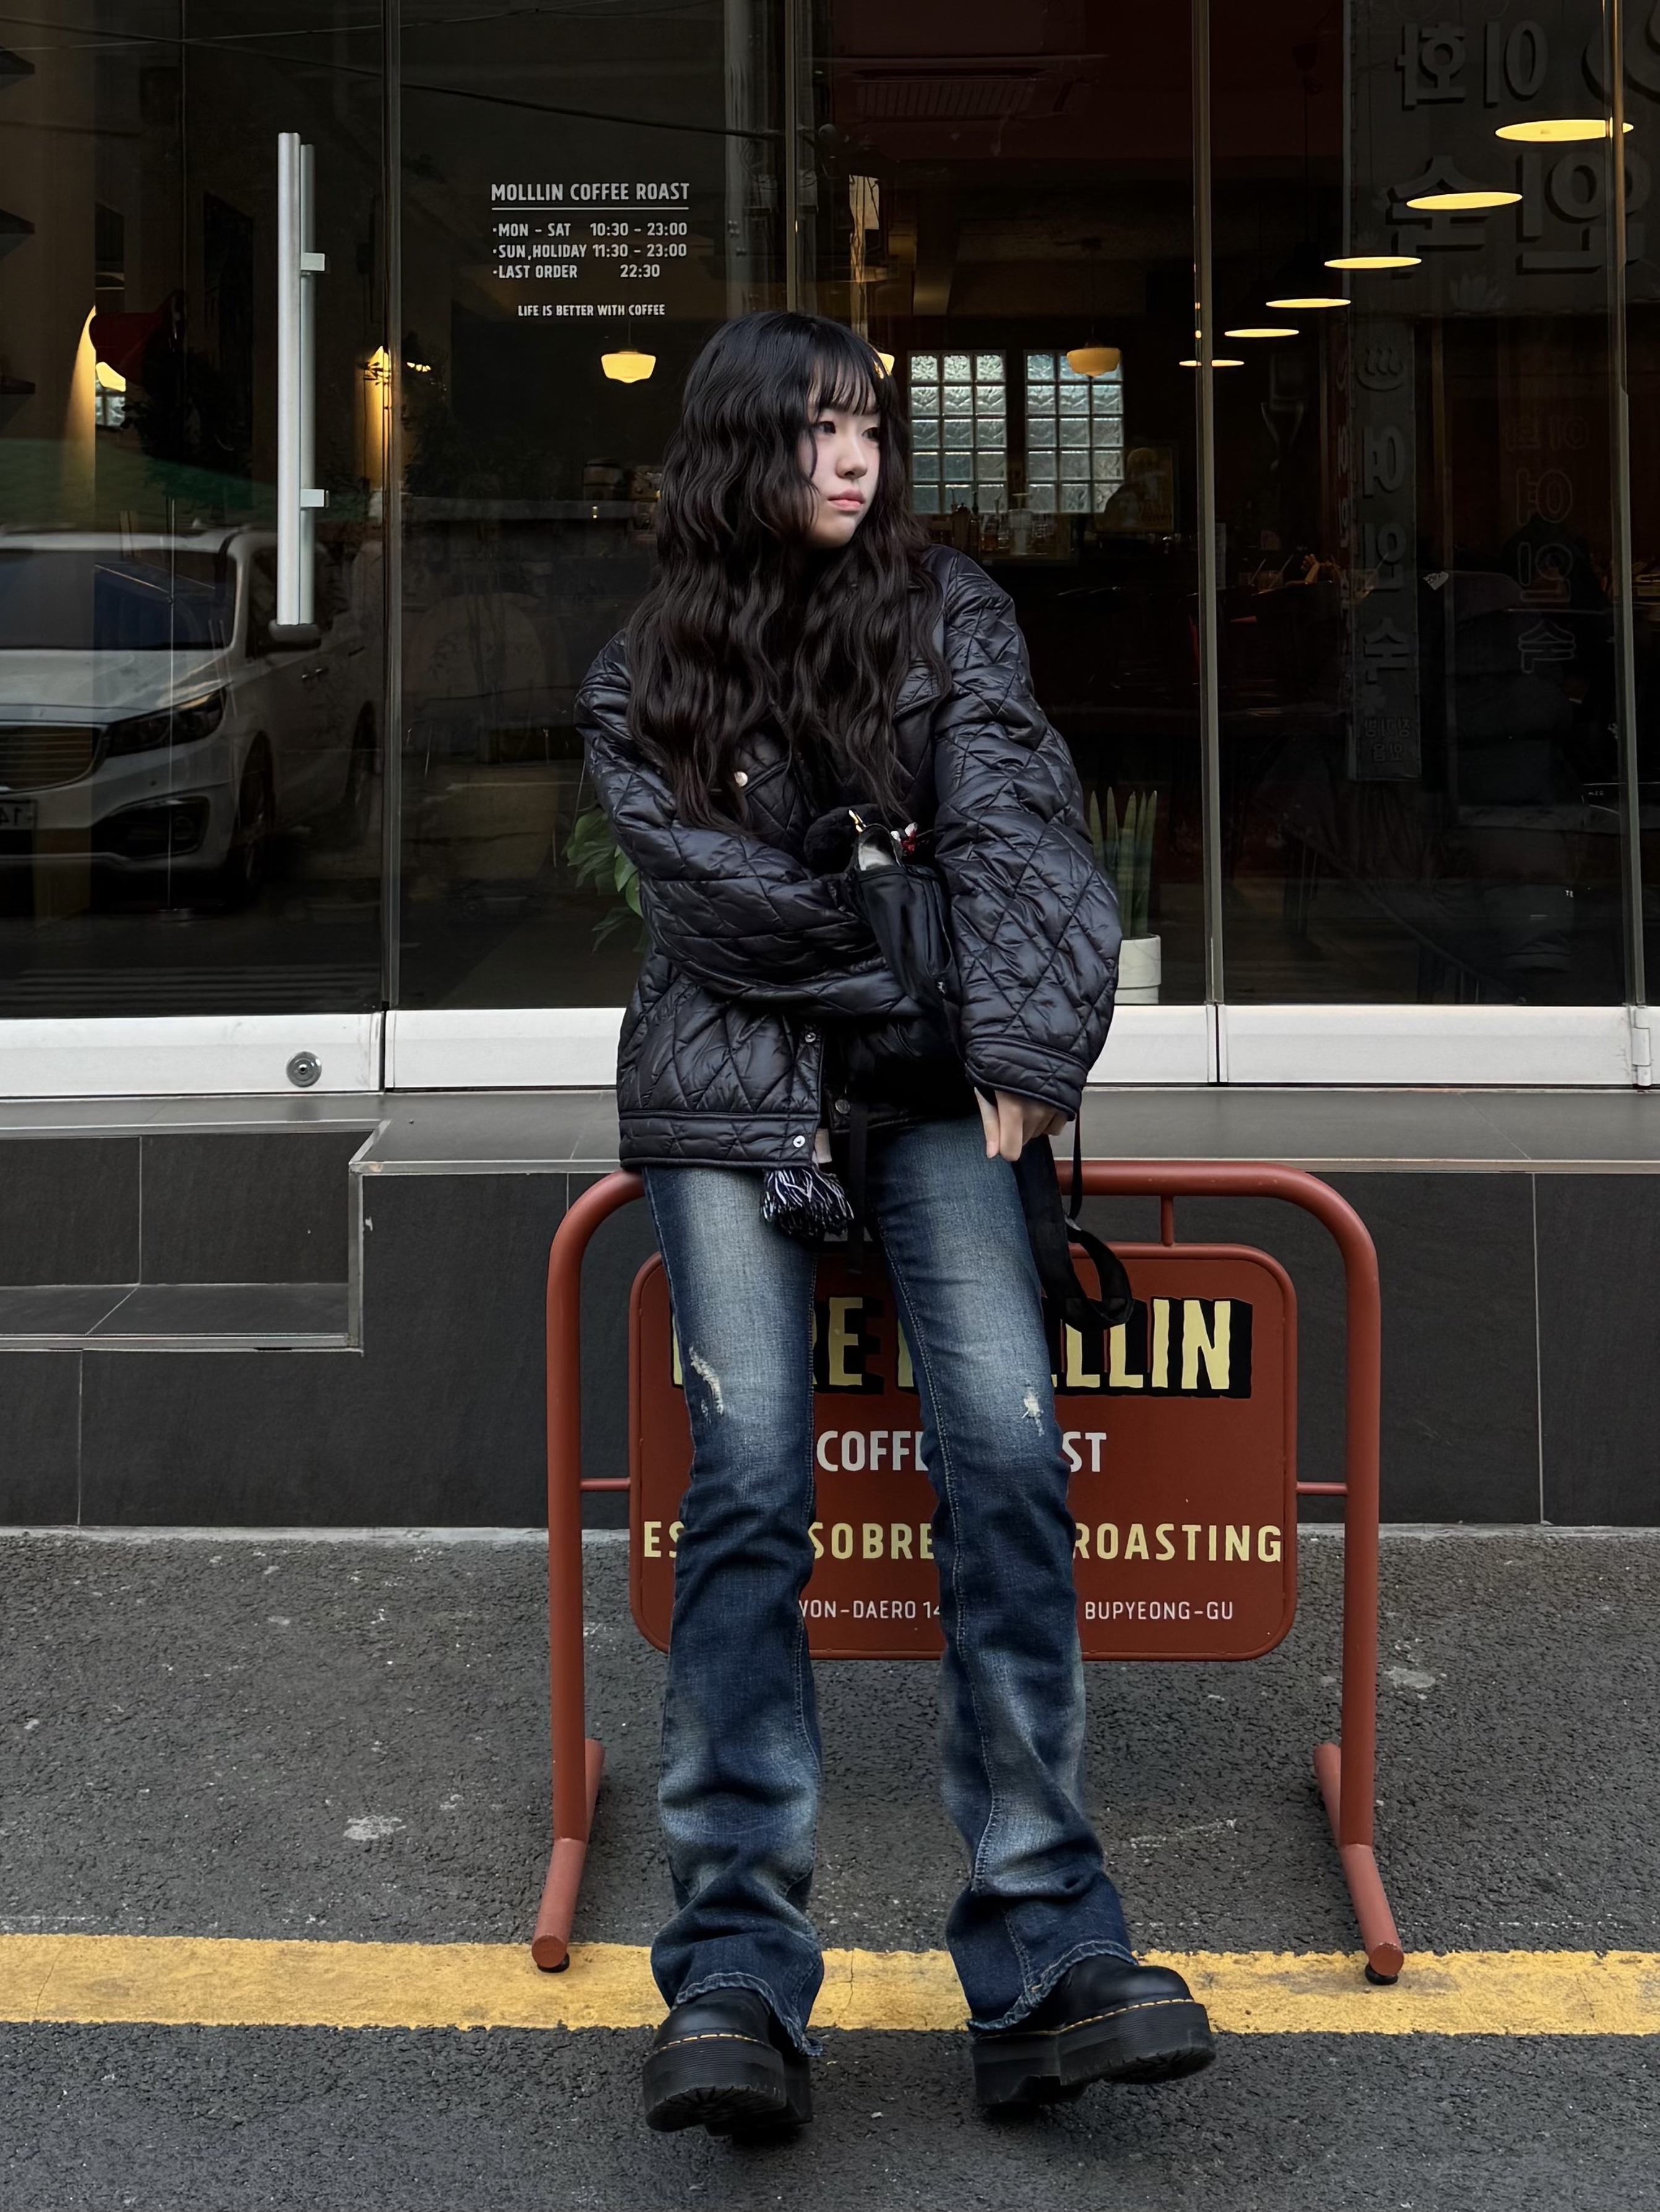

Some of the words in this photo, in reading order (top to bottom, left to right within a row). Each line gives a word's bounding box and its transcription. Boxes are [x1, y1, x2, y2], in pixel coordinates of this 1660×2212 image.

[491, 184, 563, 201] MOLLLIN
[570, 183, 629, 200] COFFEE
[636, 182, 690, 200] ROAST
[548, 223, 571, 236] SAT
[590, 223, 629, 236] 10:30
[647, 222, 687, 236] 23:00
[592, 244, 629, 257] 11:30
[647, 244, 687, 257] 23:00
[535, 265, 577, 278] ORDER
[620, 264, 660, 278] 22:30
[518, 306, 539, 316] LIFE
[543, 305, 553, 316] IS
[556, 305, 594, 316] BETTER
[597, 305, 625, 315] WITH
[629, 304, 666, 315] COFFEE
[817, 1430, 929, 1472] COFF
[1073, 1522, 1281, 1563] ROASTING
[1085, 1601, 1233, 1620] BUPYEONG-GU
